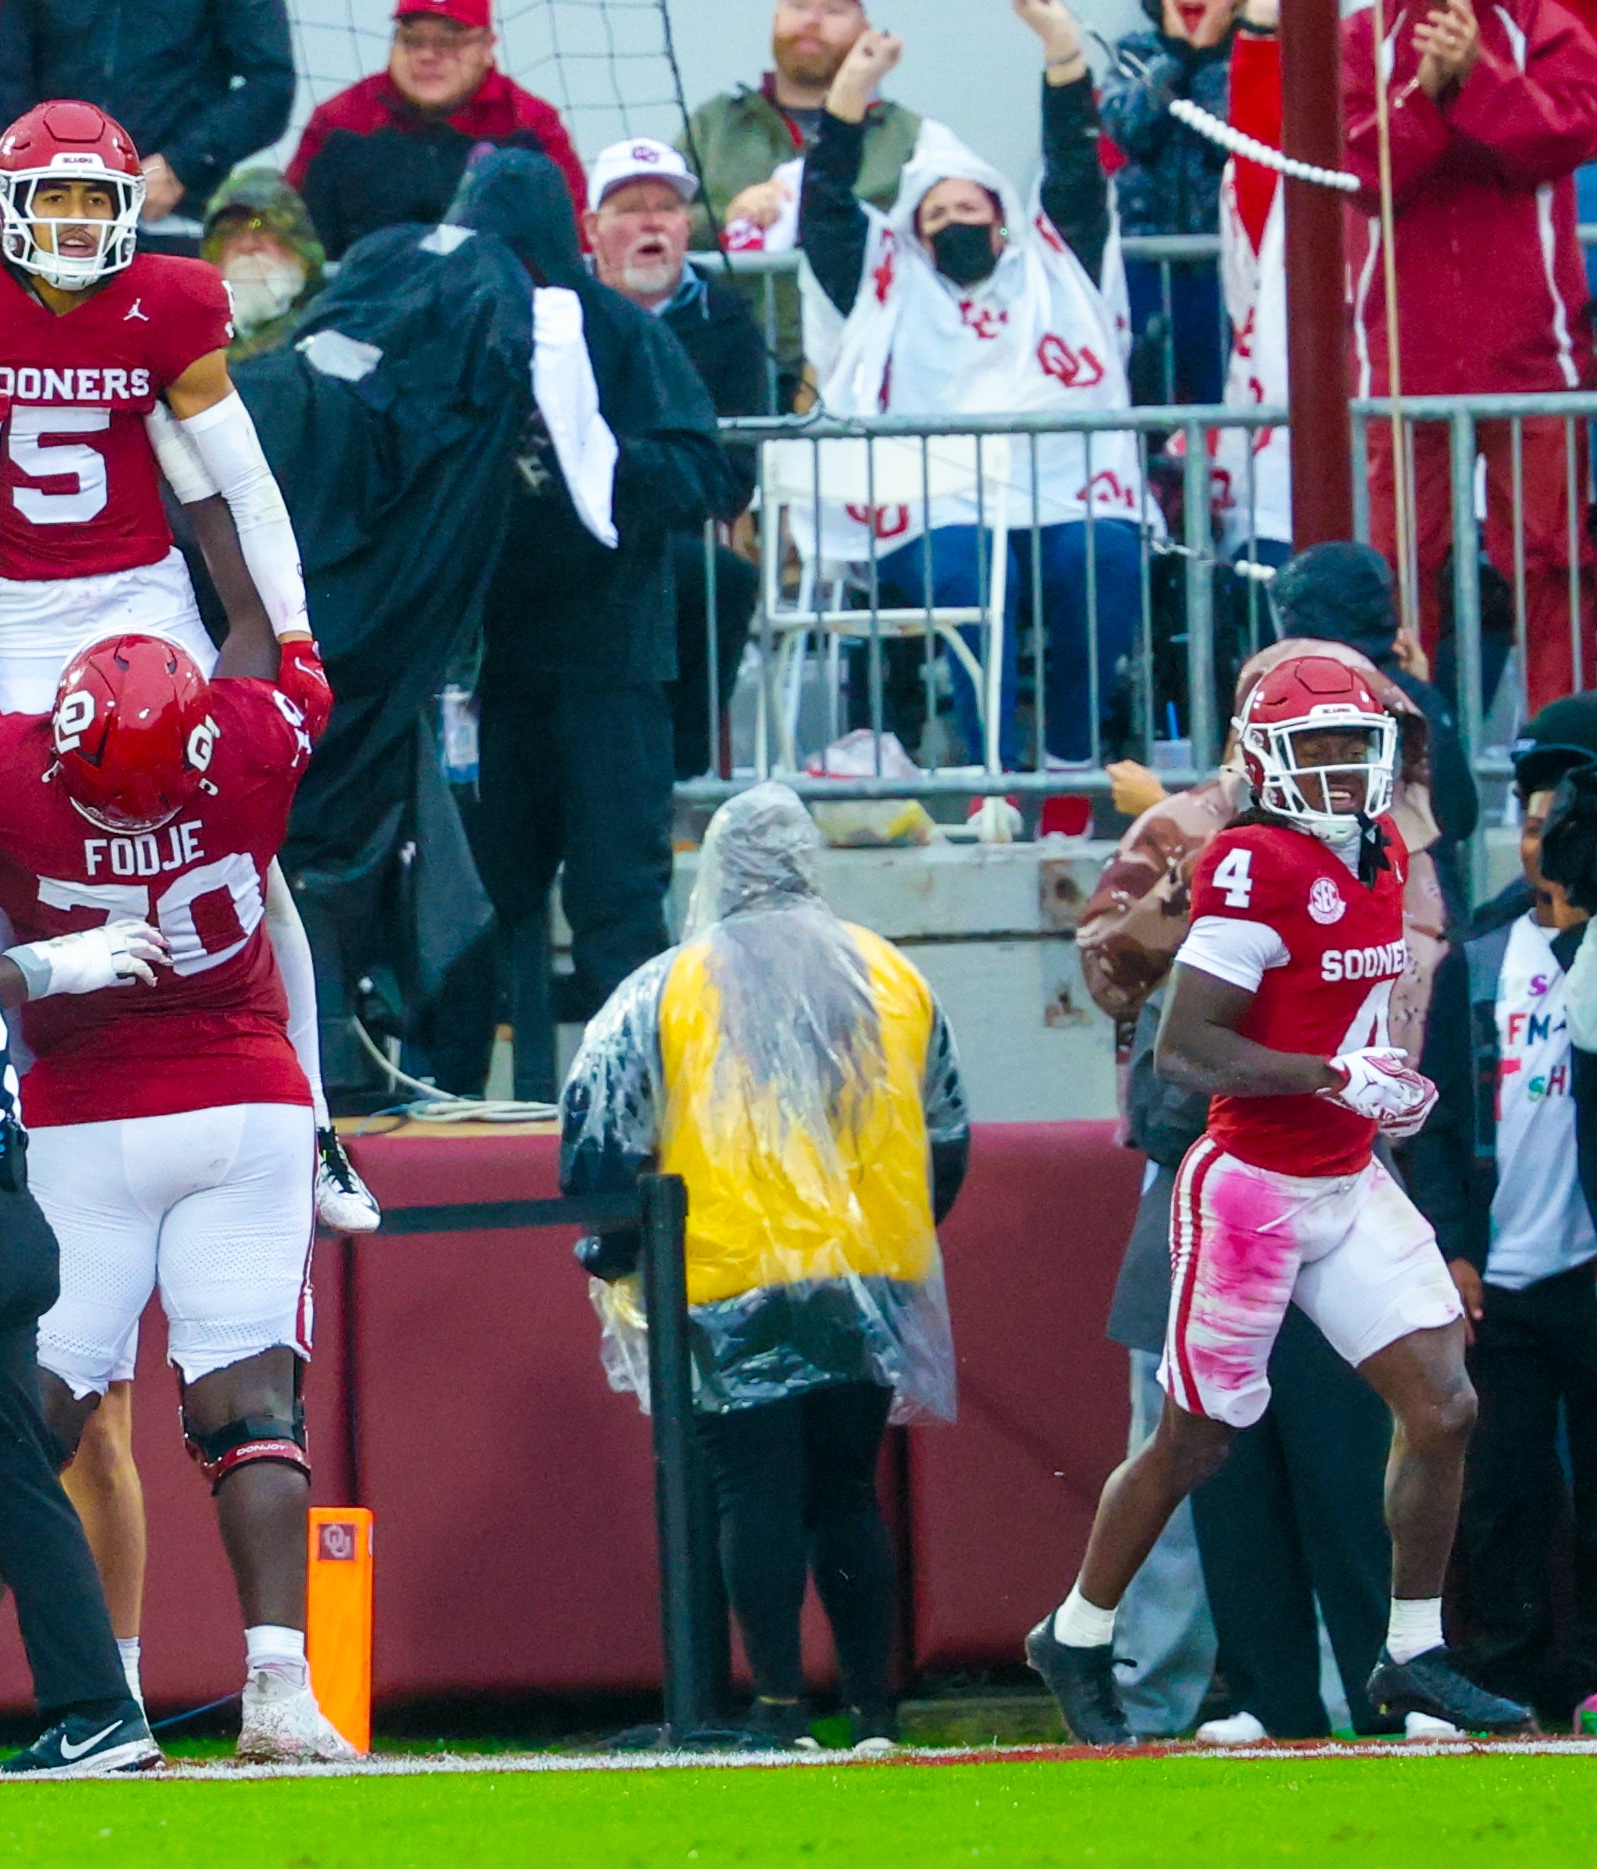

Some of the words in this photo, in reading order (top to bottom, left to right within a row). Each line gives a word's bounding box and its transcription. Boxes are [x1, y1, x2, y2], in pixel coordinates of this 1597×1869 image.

[8, 404, 111, 525] 5
[84, 820, 205, 876] FODJE
[1212, 847, 1253, 908] 4
[1311, 880, 1339, 912] SEC
[235, 1443, 287, 1457] DONJOY
[323, 1524, 352, 1559] OU
